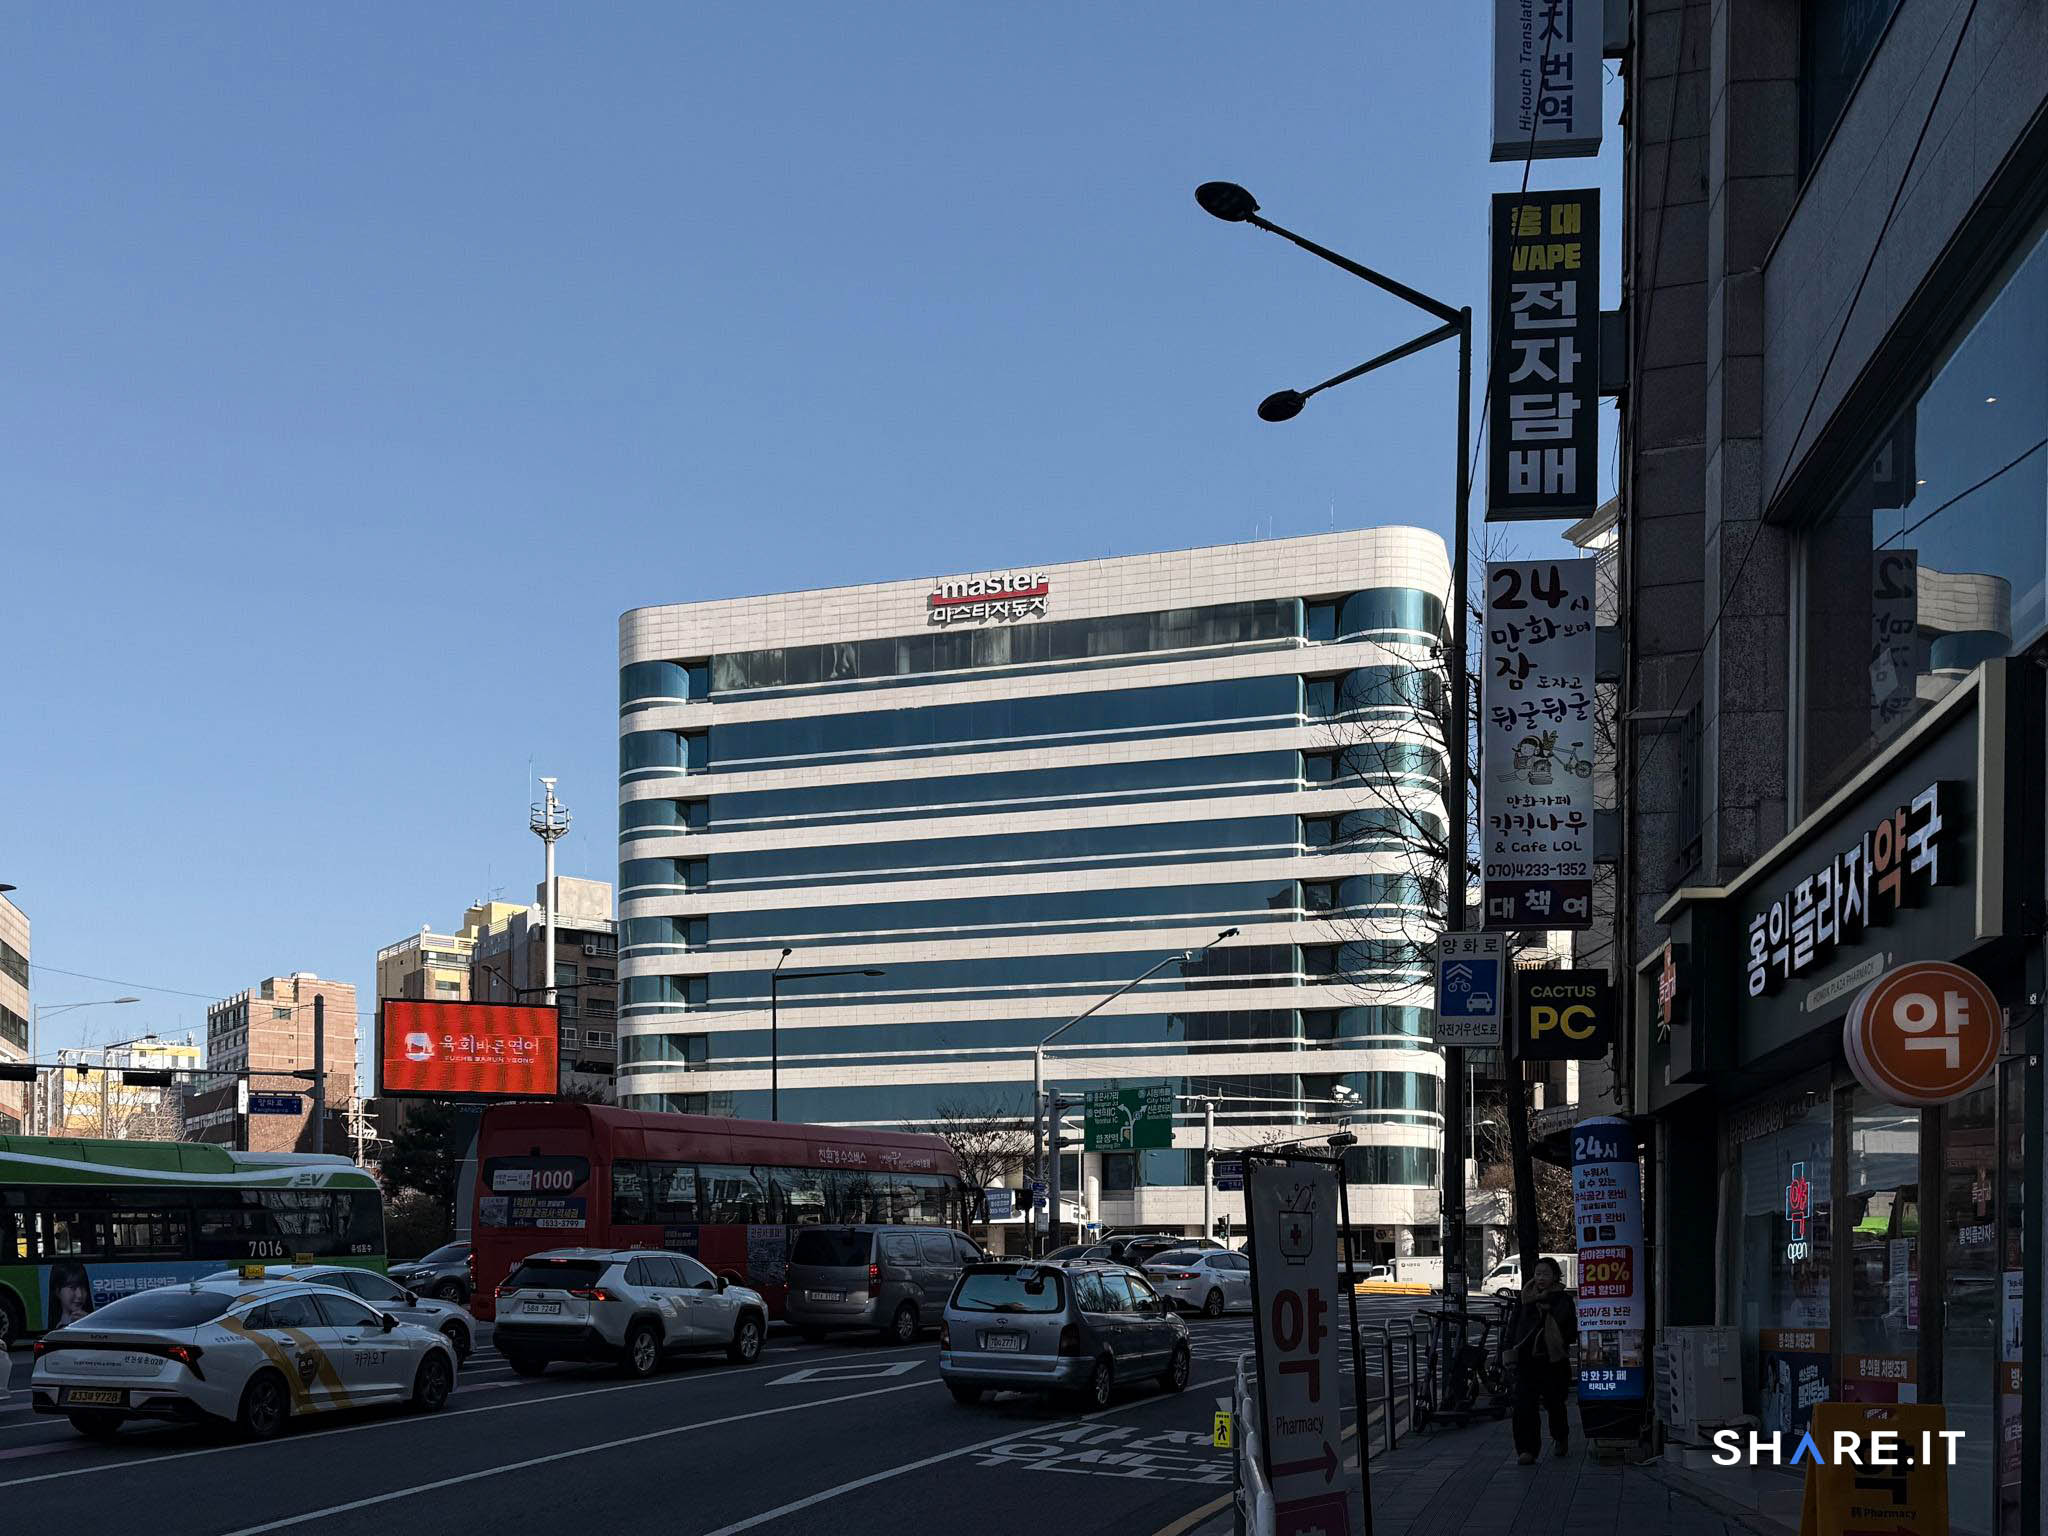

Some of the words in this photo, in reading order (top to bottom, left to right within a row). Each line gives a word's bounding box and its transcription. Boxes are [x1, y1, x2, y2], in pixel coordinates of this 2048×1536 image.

[1519, 67, 1532, 132] Hi-touch
[1510, 242, 1581, 272] VAPE
[1508, 280, 1582, 495] 전자담배
[941, 571, 1043, 599] master
[1492, 565, 1589, 611] 24시
[1491, 615, 1561, 653] 만화
[1495, 652, 1538, 690] 잠
[1491, 693, 1591, 731] 뒹굴뒹굴
[1506, 794, 1571, 809] 만화카페
[1489, 812, 1588, 837] 킥킥나무
[1494, 841, 1506, 854] &
[1511, 842, 1547, 853] Cafe
[1553, 840, 1583, 852] LOL
[1486, 863, 1587, 878] 070)4233-1352
[1748, 781, 1941, 998] 홍익플라자약국
[1442, 938, 1500, 955] 양화로
[1530, 985, 1597, 998] CACTUS
[1437, 1023, 1498, 1038] 자전거우선도로
[1530, 1004, 1597, 1040] PC
[1893, 990, 1970, 1069] 약
[1575, 1136, 1618, 1161] 24시
[297, 1172, 326, 1187] EV
[534, 1171, 573, 1190] 1000
[249, 1240, 284, 1258] 7016
[1787, 1241, 1808, 1263] open
[1585, 1261, 1630, 1282] 20%
[1600, 1318, 1626, 1329] Storage
[1272, 1288, 1328, 1403] 약
[1276, 1414, 1324, 1438] Pharmacy
[1863, 1507, 1917, 1523] Pharmacy
